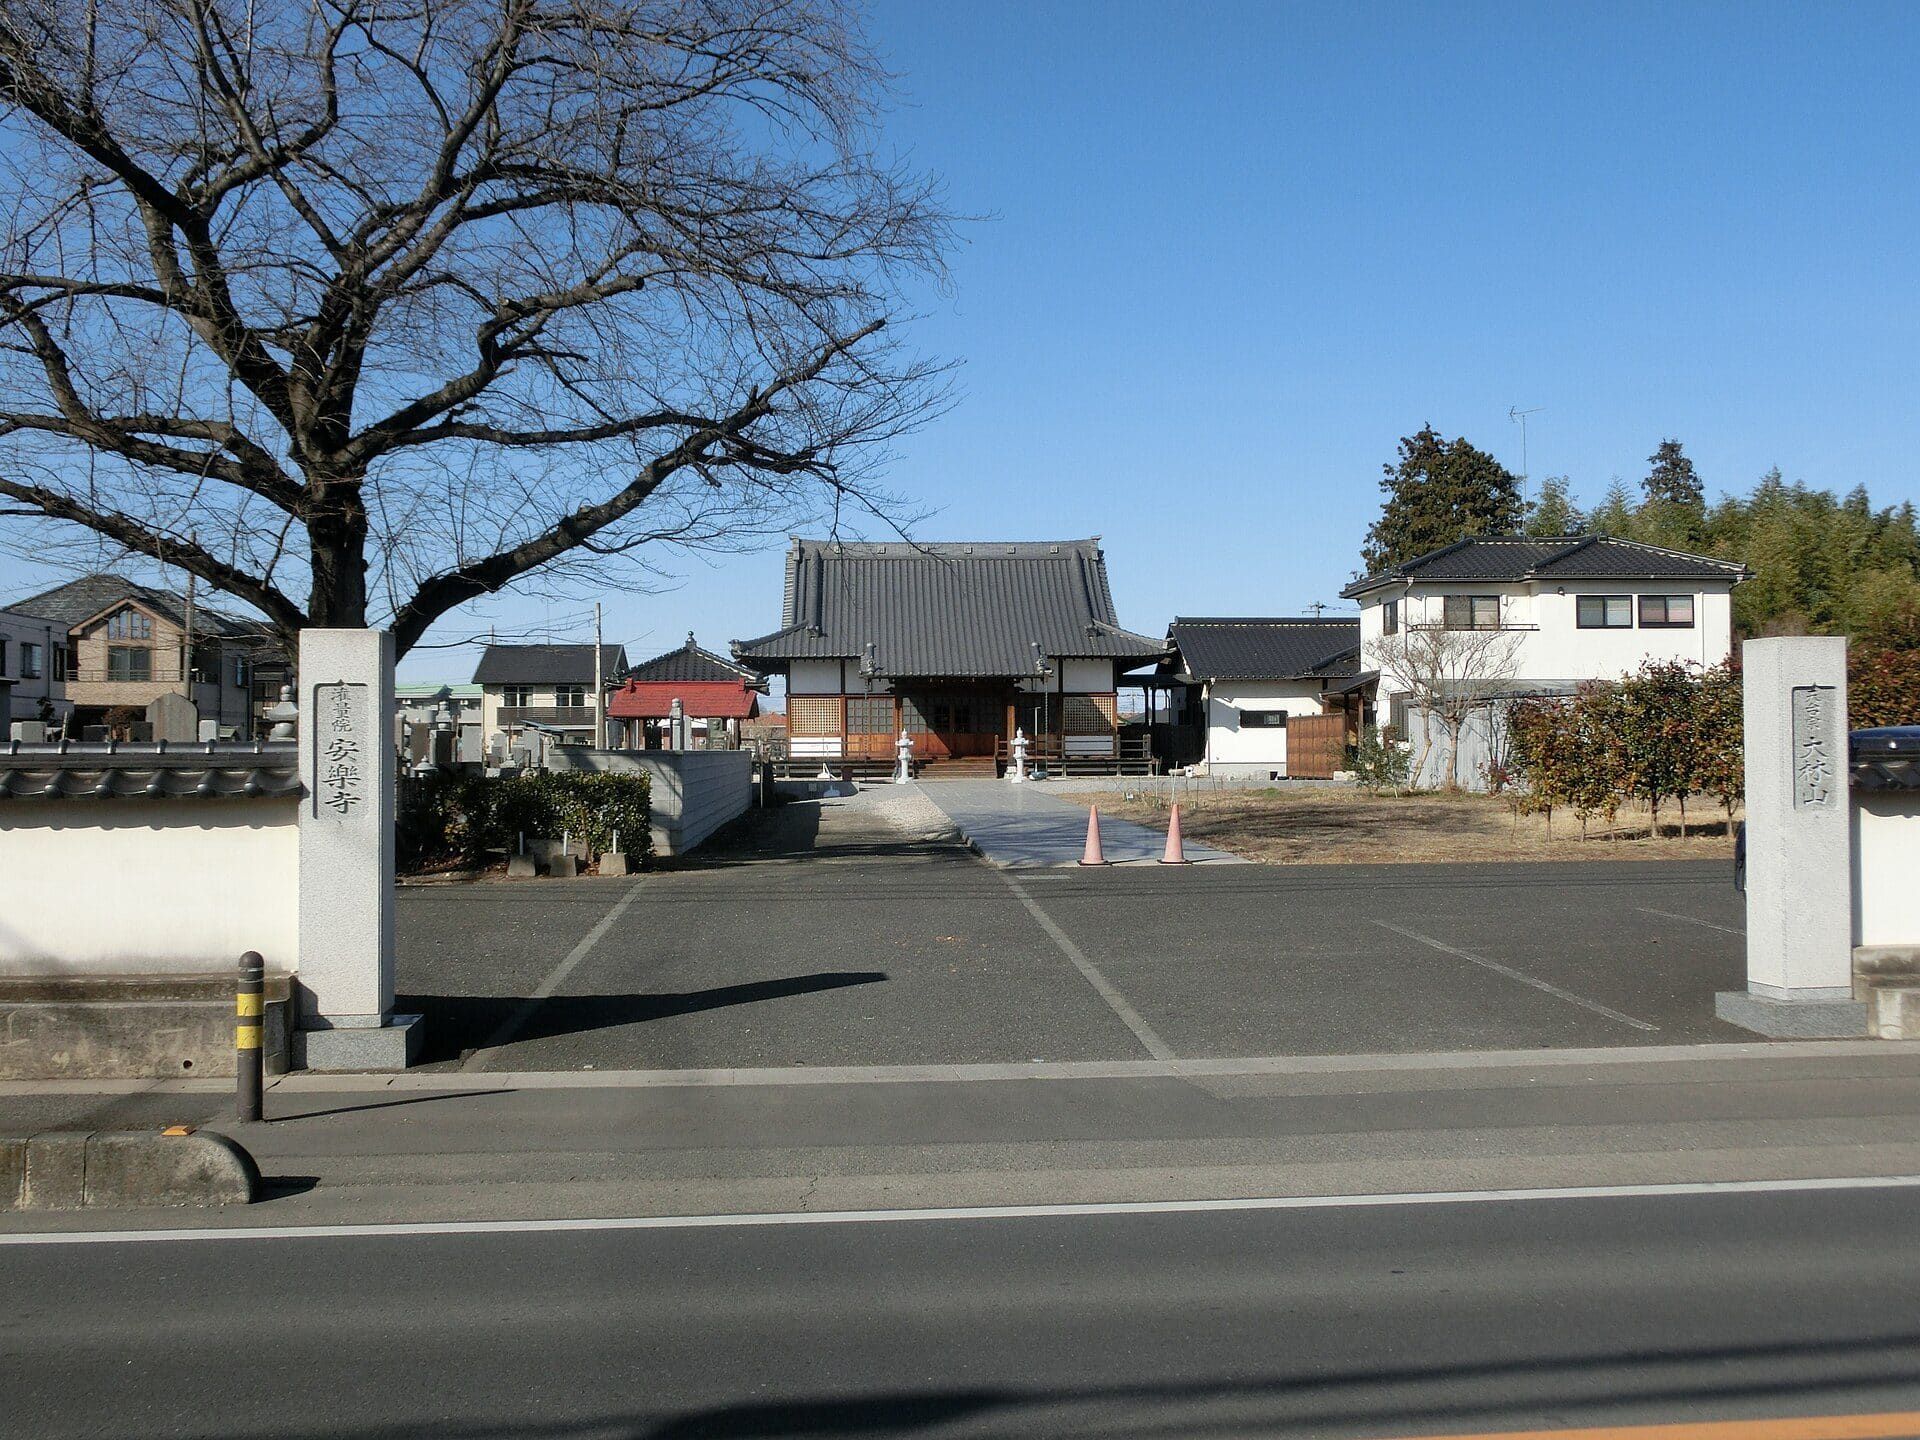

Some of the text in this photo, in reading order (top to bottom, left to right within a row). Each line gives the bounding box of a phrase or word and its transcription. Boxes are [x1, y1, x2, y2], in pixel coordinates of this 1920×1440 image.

[322, 738, 362, 814] 安樂寺
[1798, 736, 1832, 804] 大林山
